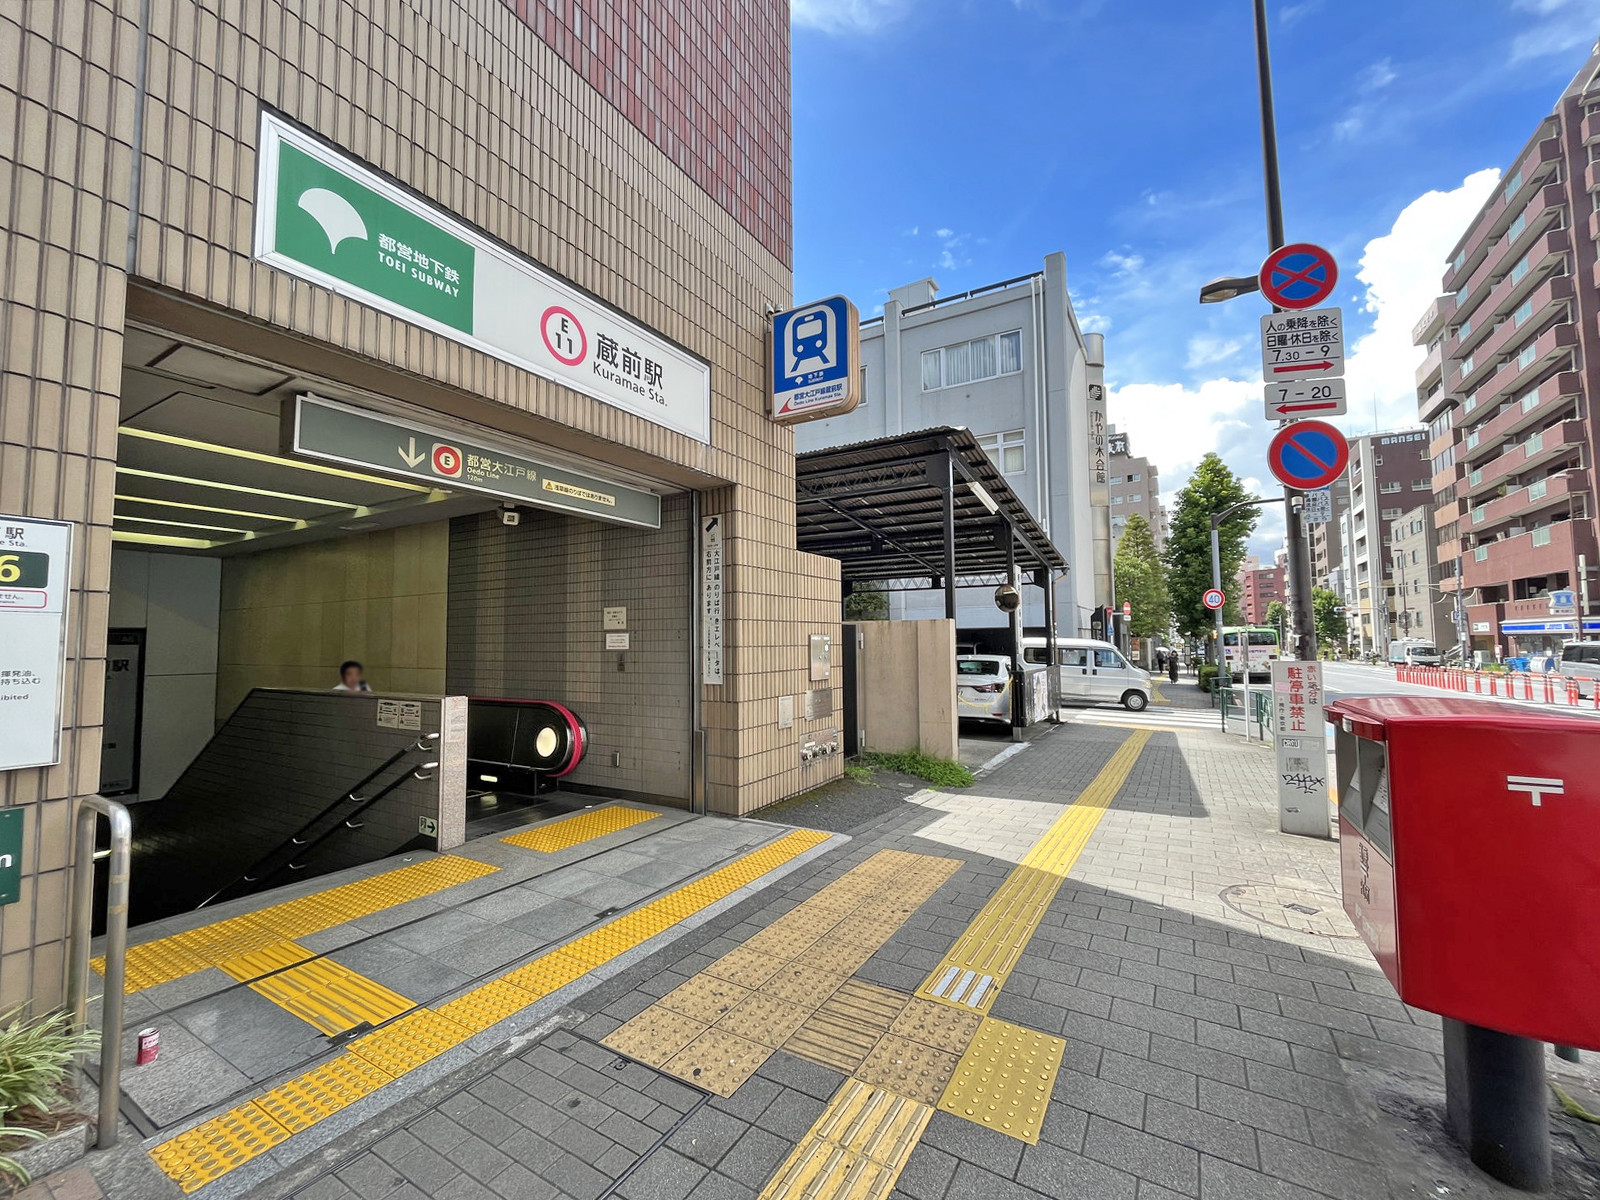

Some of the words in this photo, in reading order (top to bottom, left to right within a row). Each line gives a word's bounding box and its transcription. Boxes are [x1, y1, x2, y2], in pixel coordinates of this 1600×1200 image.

[378, 233, 460, 285] 都営地下鉄
[378, 251, 406, 273] TOEI
[410, 267, 459, 298] SUBWAY
[561, 317, 569, 334] E
[1265, 315, 1338, 333] 人の乗降を除く
[555, 332, 573, 355] 11
[1266, 330, 1340, 347] 日曜・休日を除く
[596, 332, 664, 390] 蔵前駅
[593, 361, 646, 396] Kuramae
[648, 388, 668, 407] Sta.
[1095, 410, 1105, 483] かやの木会館
[443, 455, 451, 466] E
[466, 454, 537, 482] 都営大江戸線
[466, 466, 485, 477] Oedo
[486, 471, 500, 480] Line
[466, 474, 483, 483] 120m
[0, 526, 24, 541] 駅
[8, 540, 28, 548] Sta.
[1208, 594, 1220, 604] 40
[0, 677, 41, 686] 持ち込む
[1287, 667, 1306, 732] 駐停車禁止
